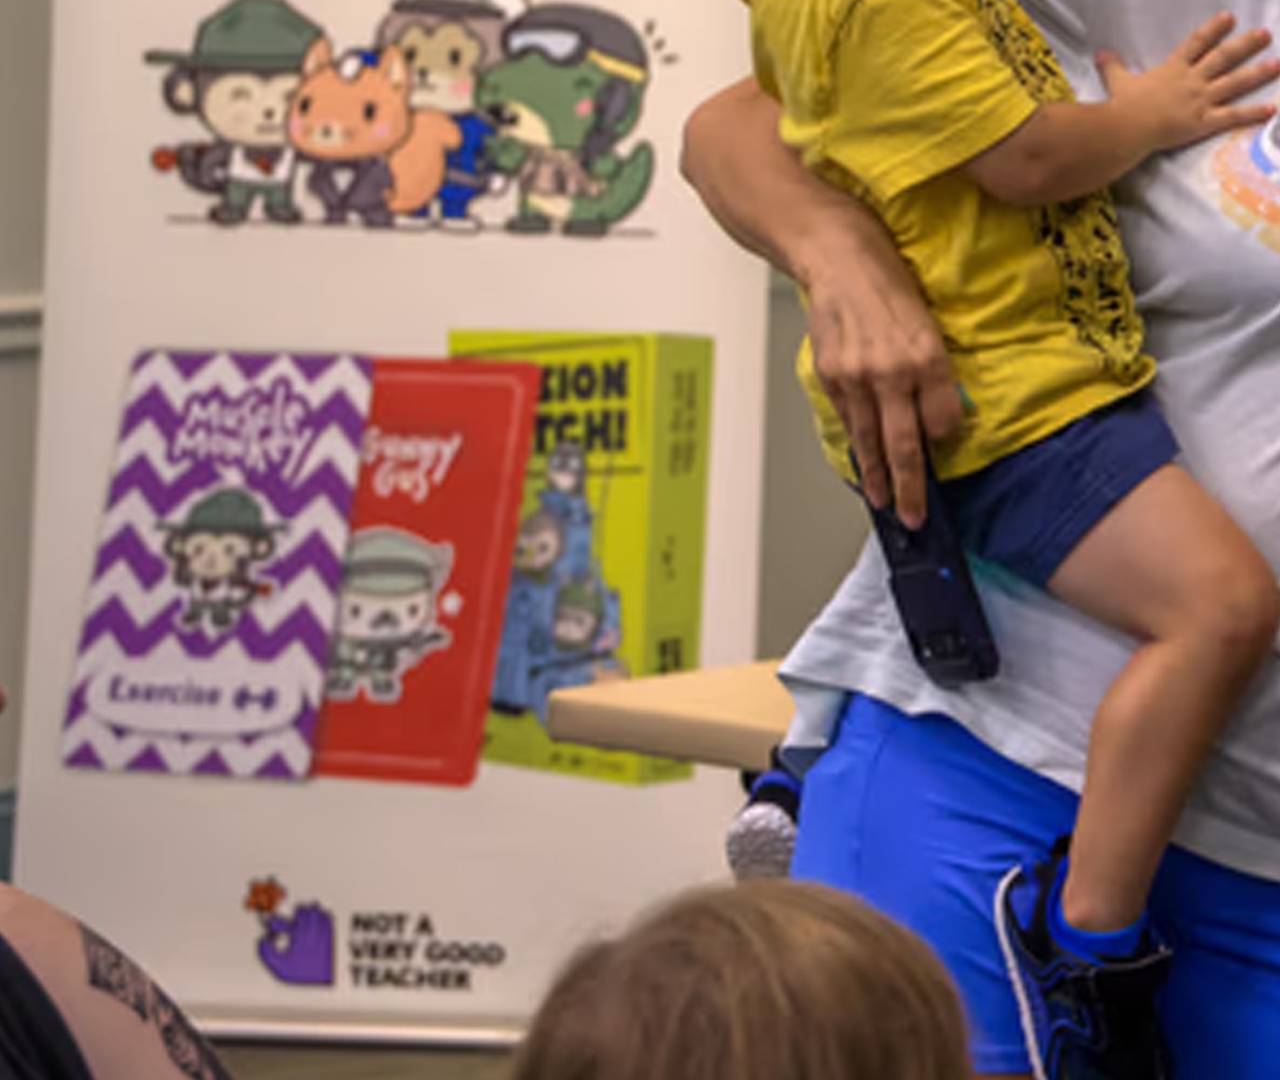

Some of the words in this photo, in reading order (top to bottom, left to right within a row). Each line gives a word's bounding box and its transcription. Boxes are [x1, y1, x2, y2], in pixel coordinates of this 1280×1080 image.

[351, 913, 406, 935] NOT
[416, 913, 434, 936] A
[349, 940, 416, 961] VERY
[425, 941, 506, 966] GOOD
[350, 963, 471, 990] TEACHER
